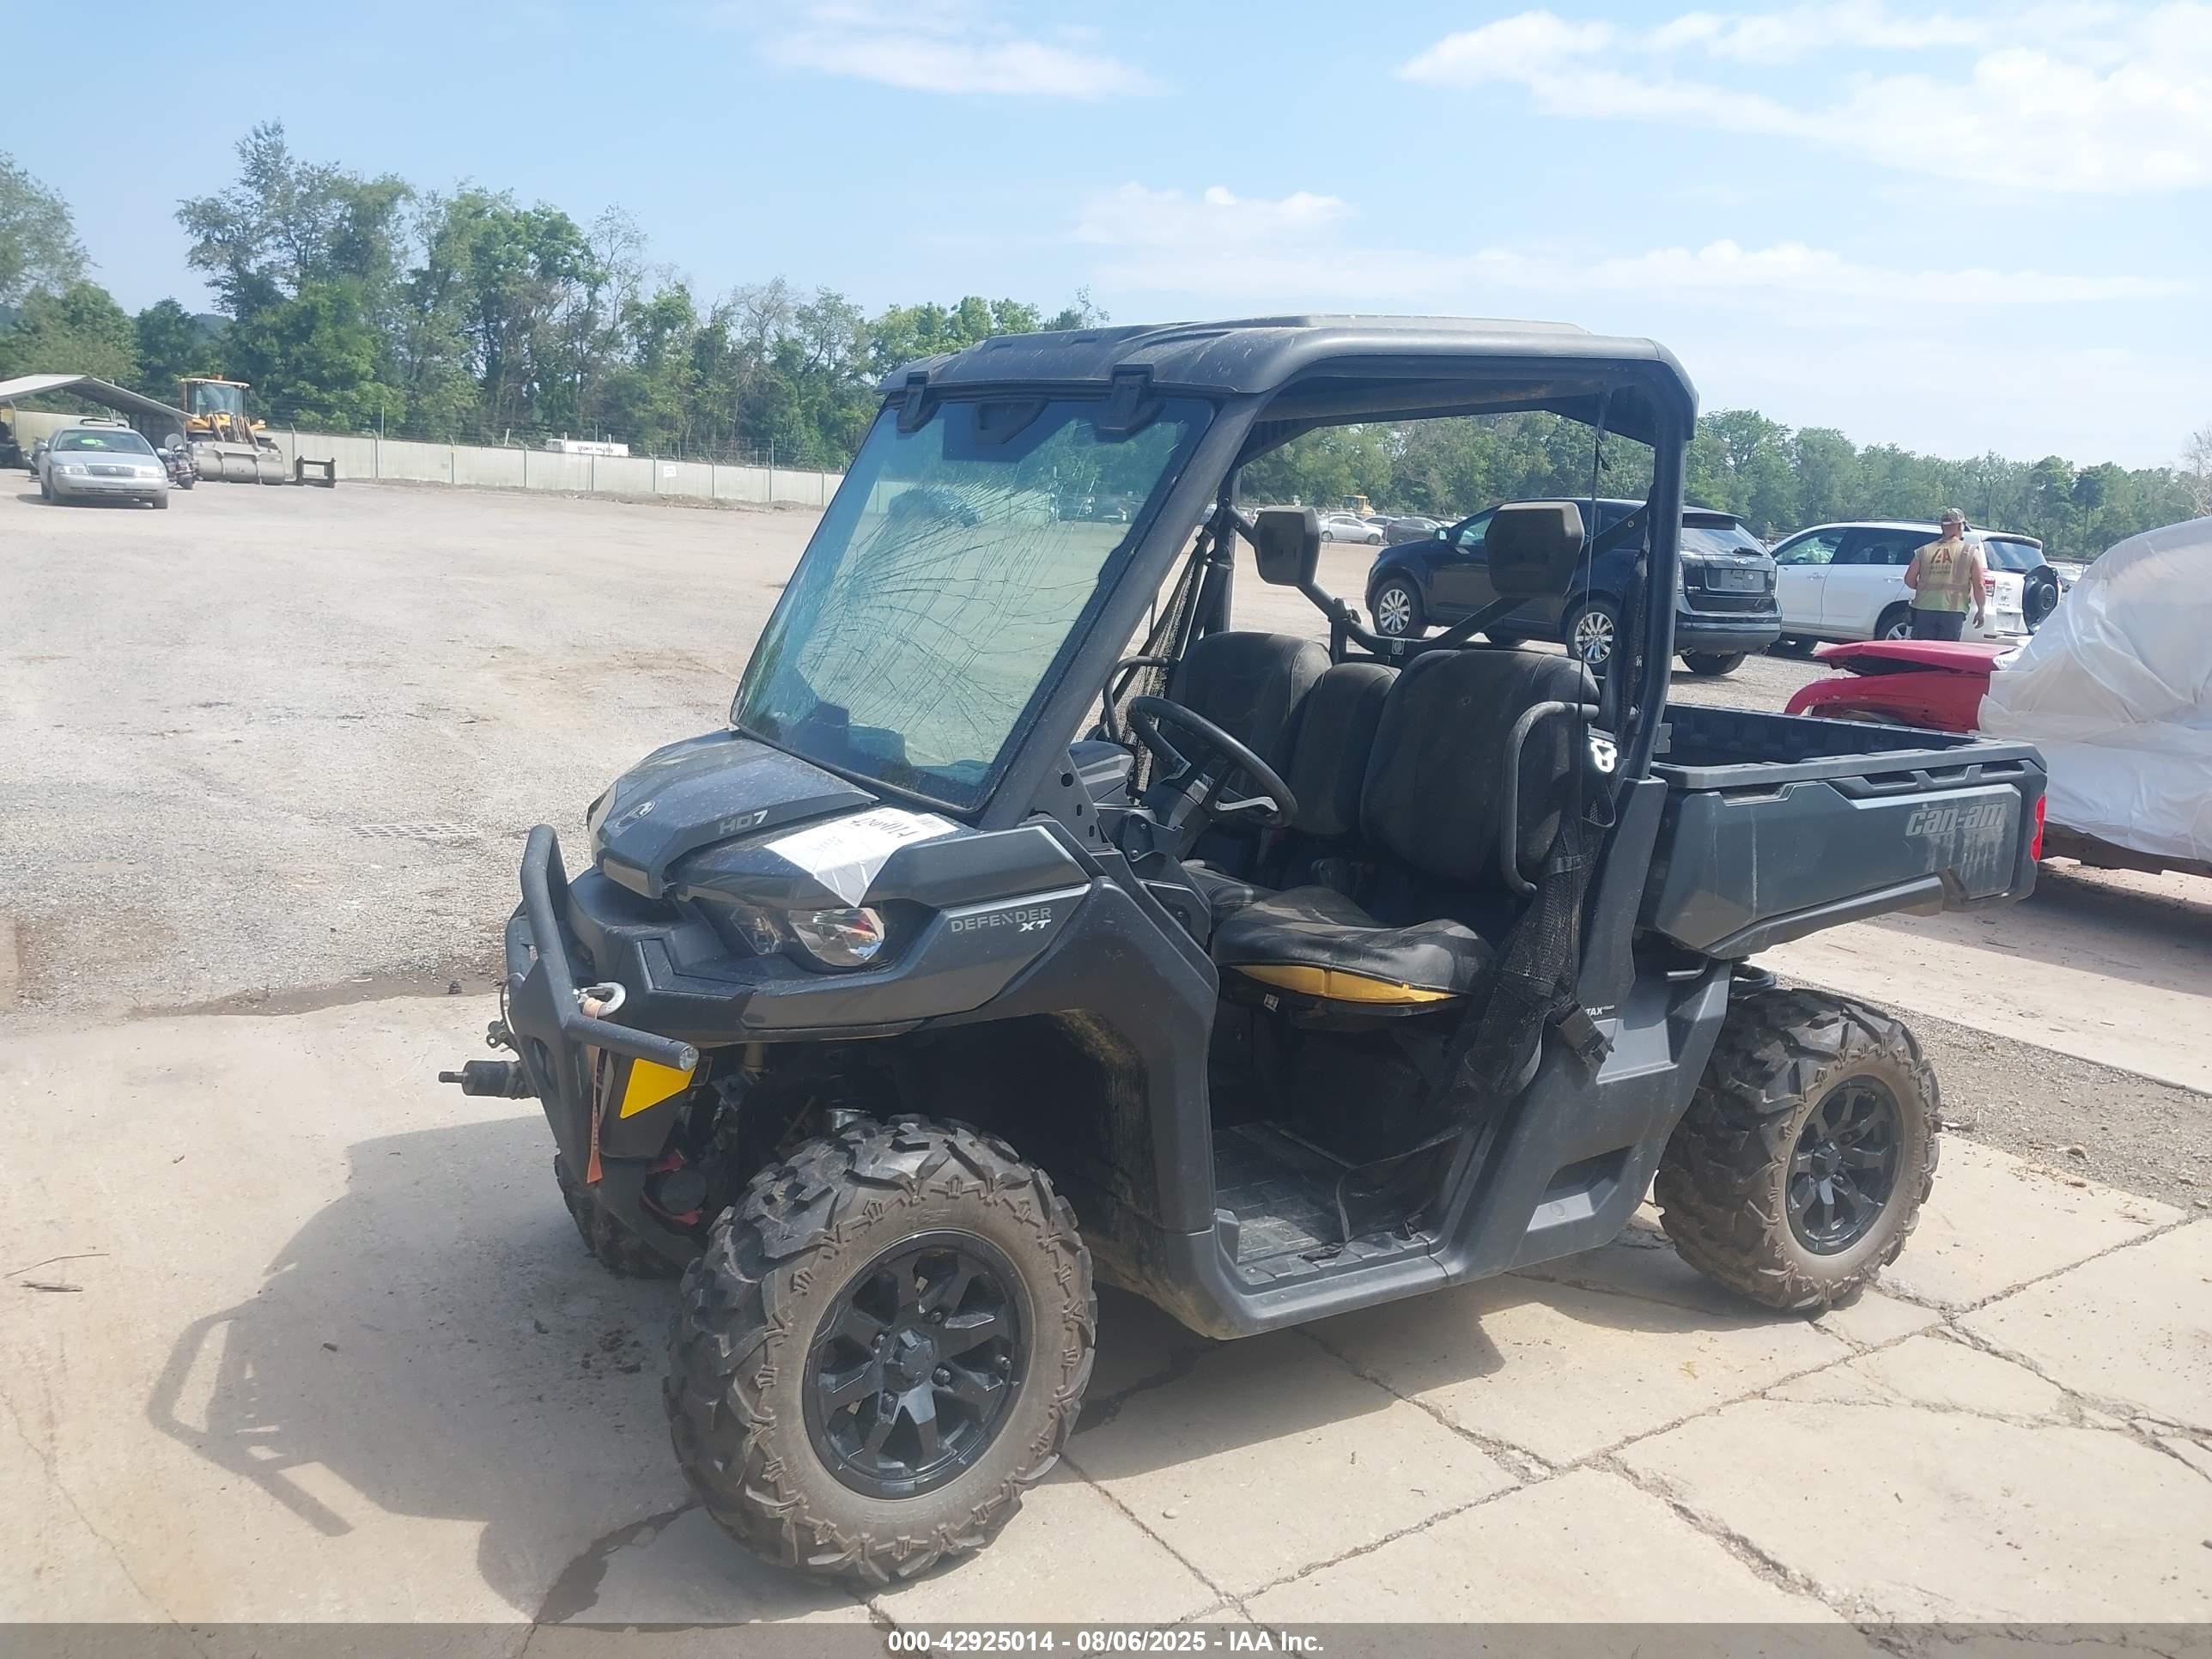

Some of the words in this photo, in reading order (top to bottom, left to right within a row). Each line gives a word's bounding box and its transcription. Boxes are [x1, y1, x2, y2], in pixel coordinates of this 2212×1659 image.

[719, 809, 769, 835] HD7
[950, 907, 1052, 933] DEFENDER
[1018, 919, 1052, 933] XT
[1584, 1006, 1603, 1017] TAX
